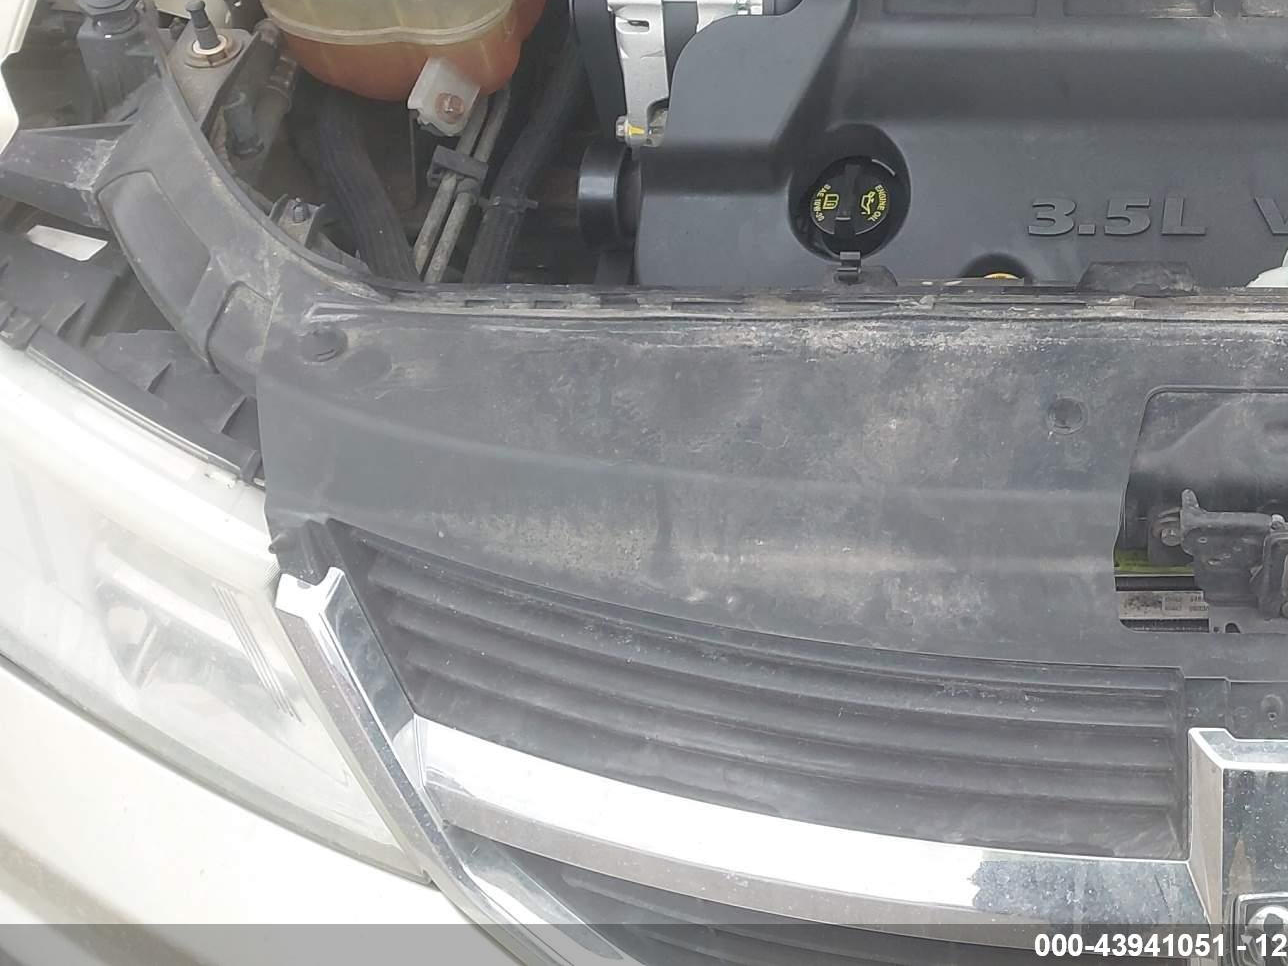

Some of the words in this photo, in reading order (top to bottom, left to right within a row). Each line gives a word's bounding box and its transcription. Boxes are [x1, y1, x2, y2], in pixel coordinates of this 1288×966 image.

[874, 184, 887, 211] ENGINE
[868, 211, 881, 222] OIL
[1028, 196, 1206, 235] 3.5L
